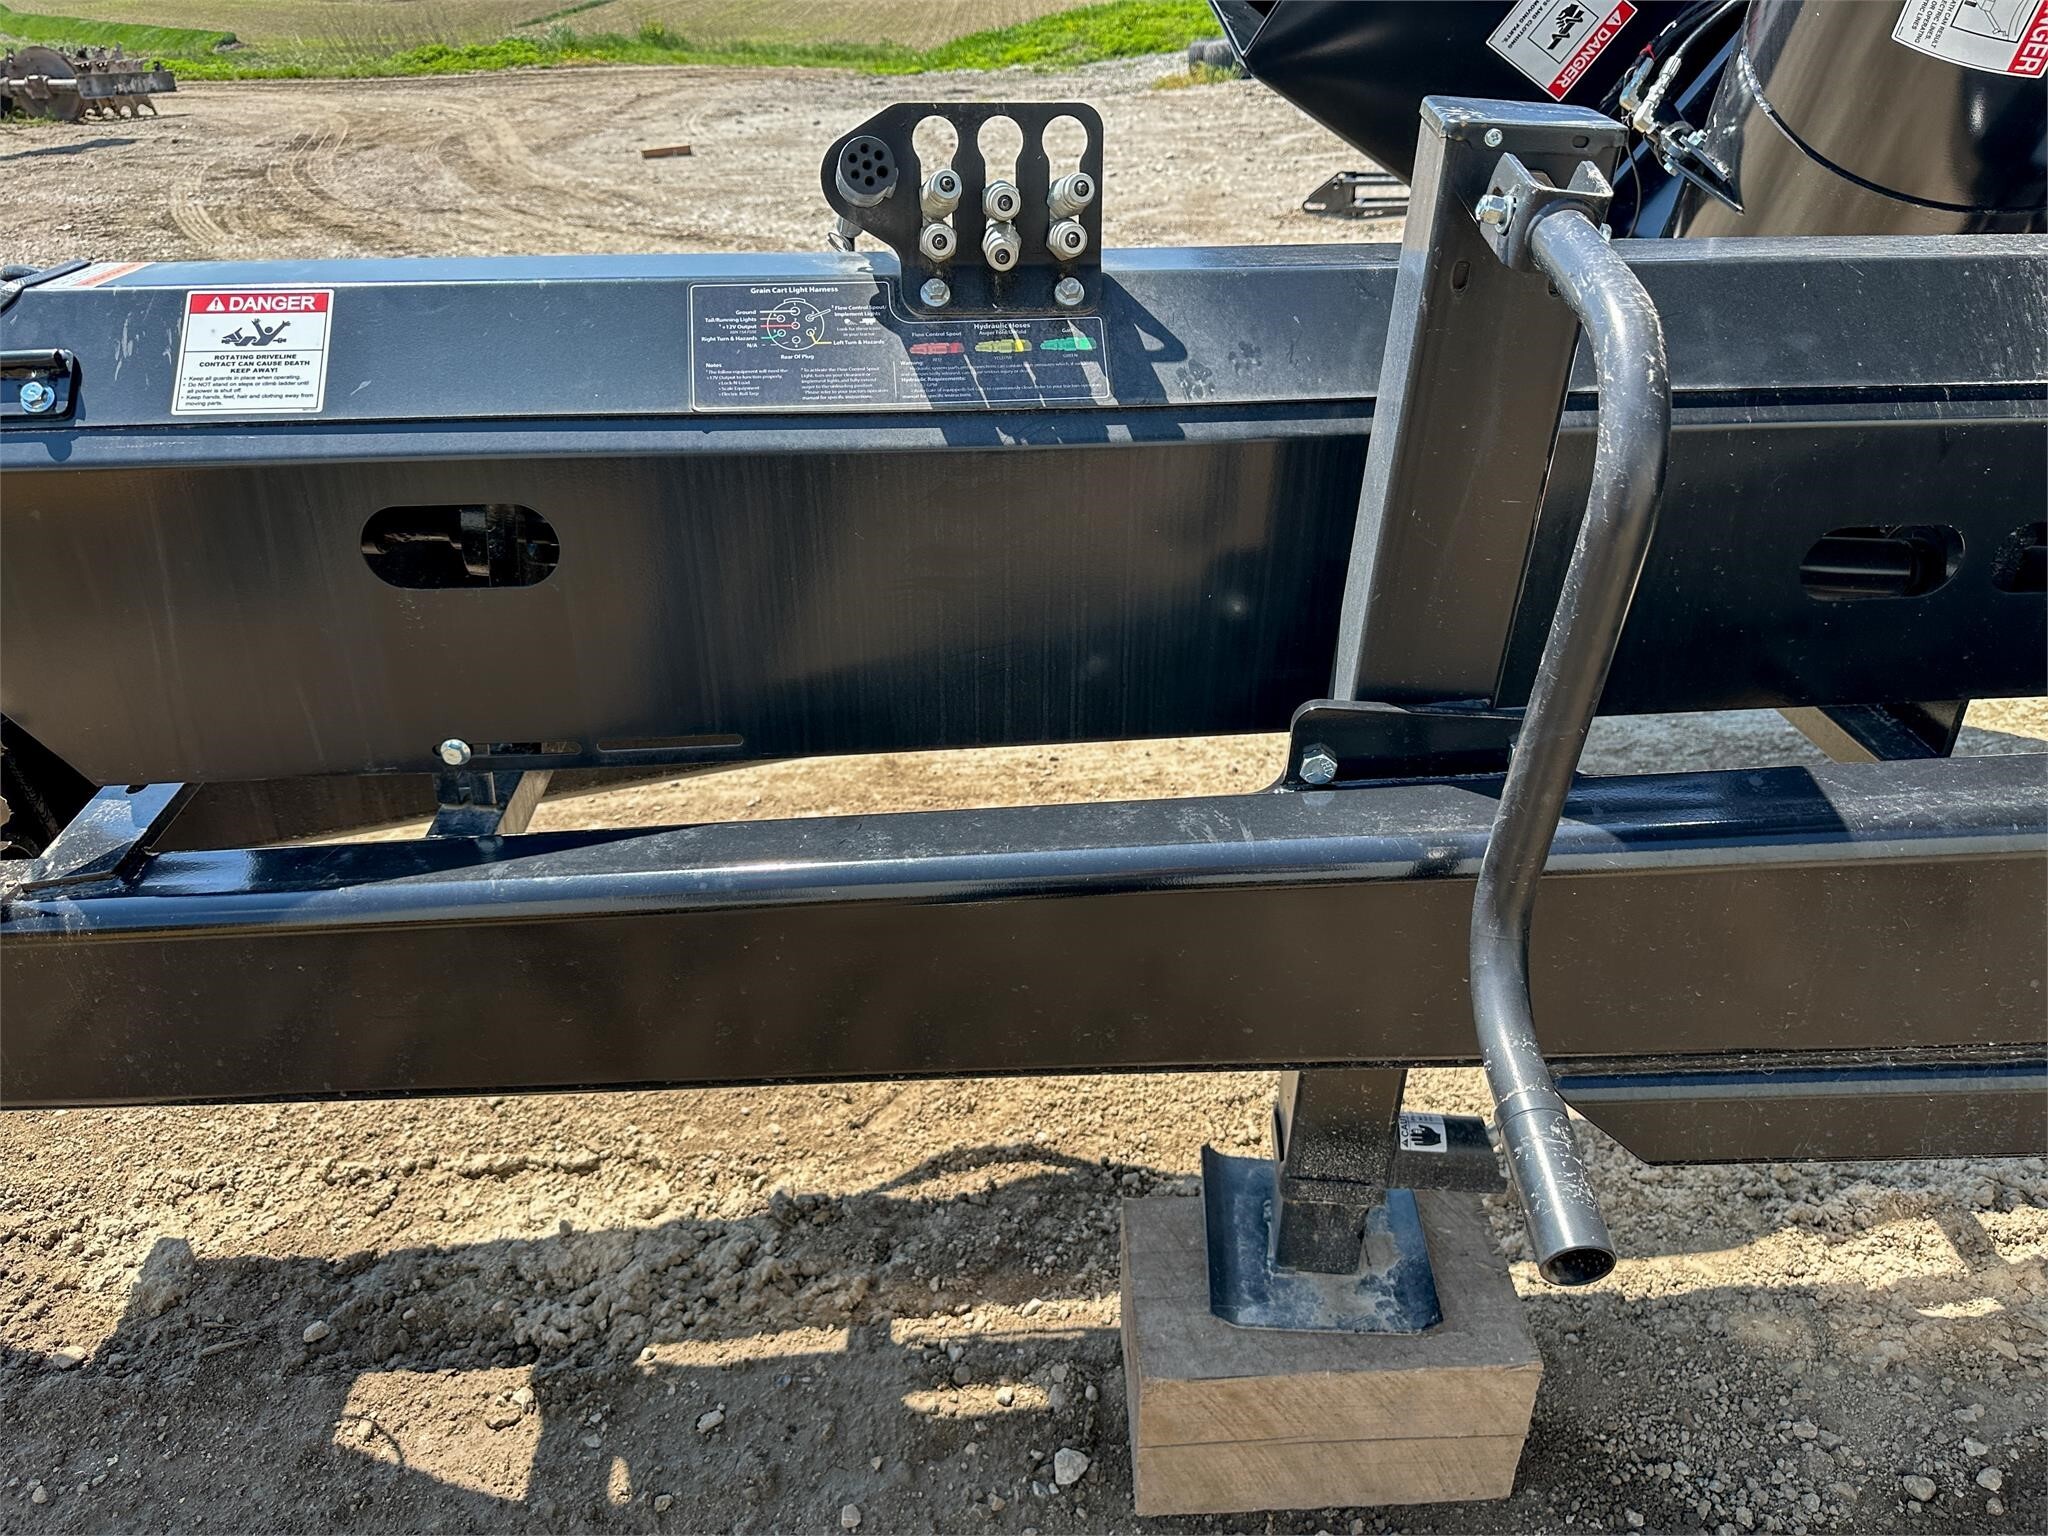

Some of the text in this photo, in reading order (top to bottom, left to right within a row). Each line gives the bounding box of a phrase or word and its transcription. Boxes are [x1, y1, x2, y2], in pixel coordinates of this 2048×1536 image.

[1519, 0, 1539, 23] MOVING
[1912, 12, 1922, 30] LINES
[1941, 12, 1951, 26] CAN
[1508, 6, 1543, 49] AND CLOTHING
[1914, 10, 1932, 44] OPERATING
[1931, 26, 1944, 48] RESULT
[1556, 27, 1612, 88] DANGER
[228, 296, 316, 312] DANGER
